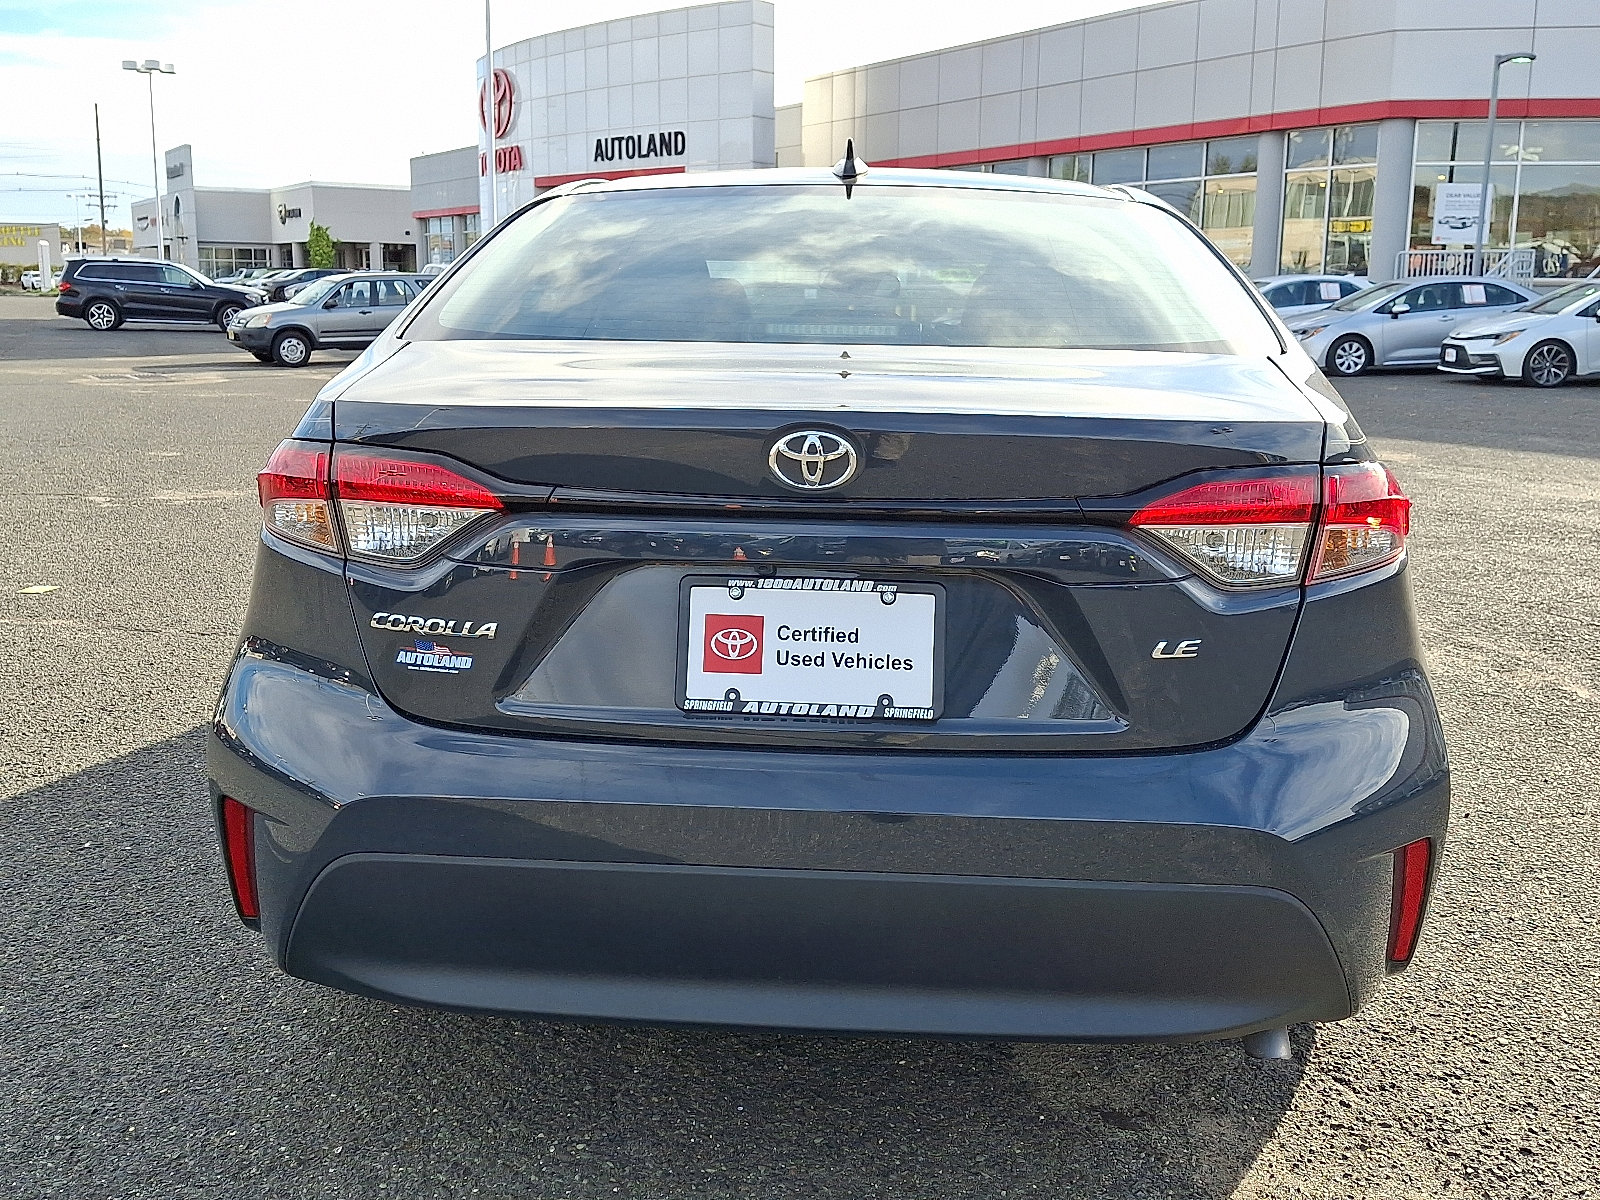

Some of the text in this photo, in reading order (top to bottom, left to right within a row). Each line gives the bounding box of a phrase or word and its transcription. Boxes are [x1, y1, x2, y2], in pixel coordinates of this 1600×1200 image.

[594, 131, 686, 162] AUTOLAND
[370, 611, 498, 640] COROLLA
[776, 624, 859, 644] Certified
[1152, 639, 1202, 659] LE
[396, 650, 473, 670] AUTOLAND
[776, 650, 914, 671] Used Vehicles
[684, 699, 934, 720] SPRINGFIELD AUTOLAND SPRINGFIELD
